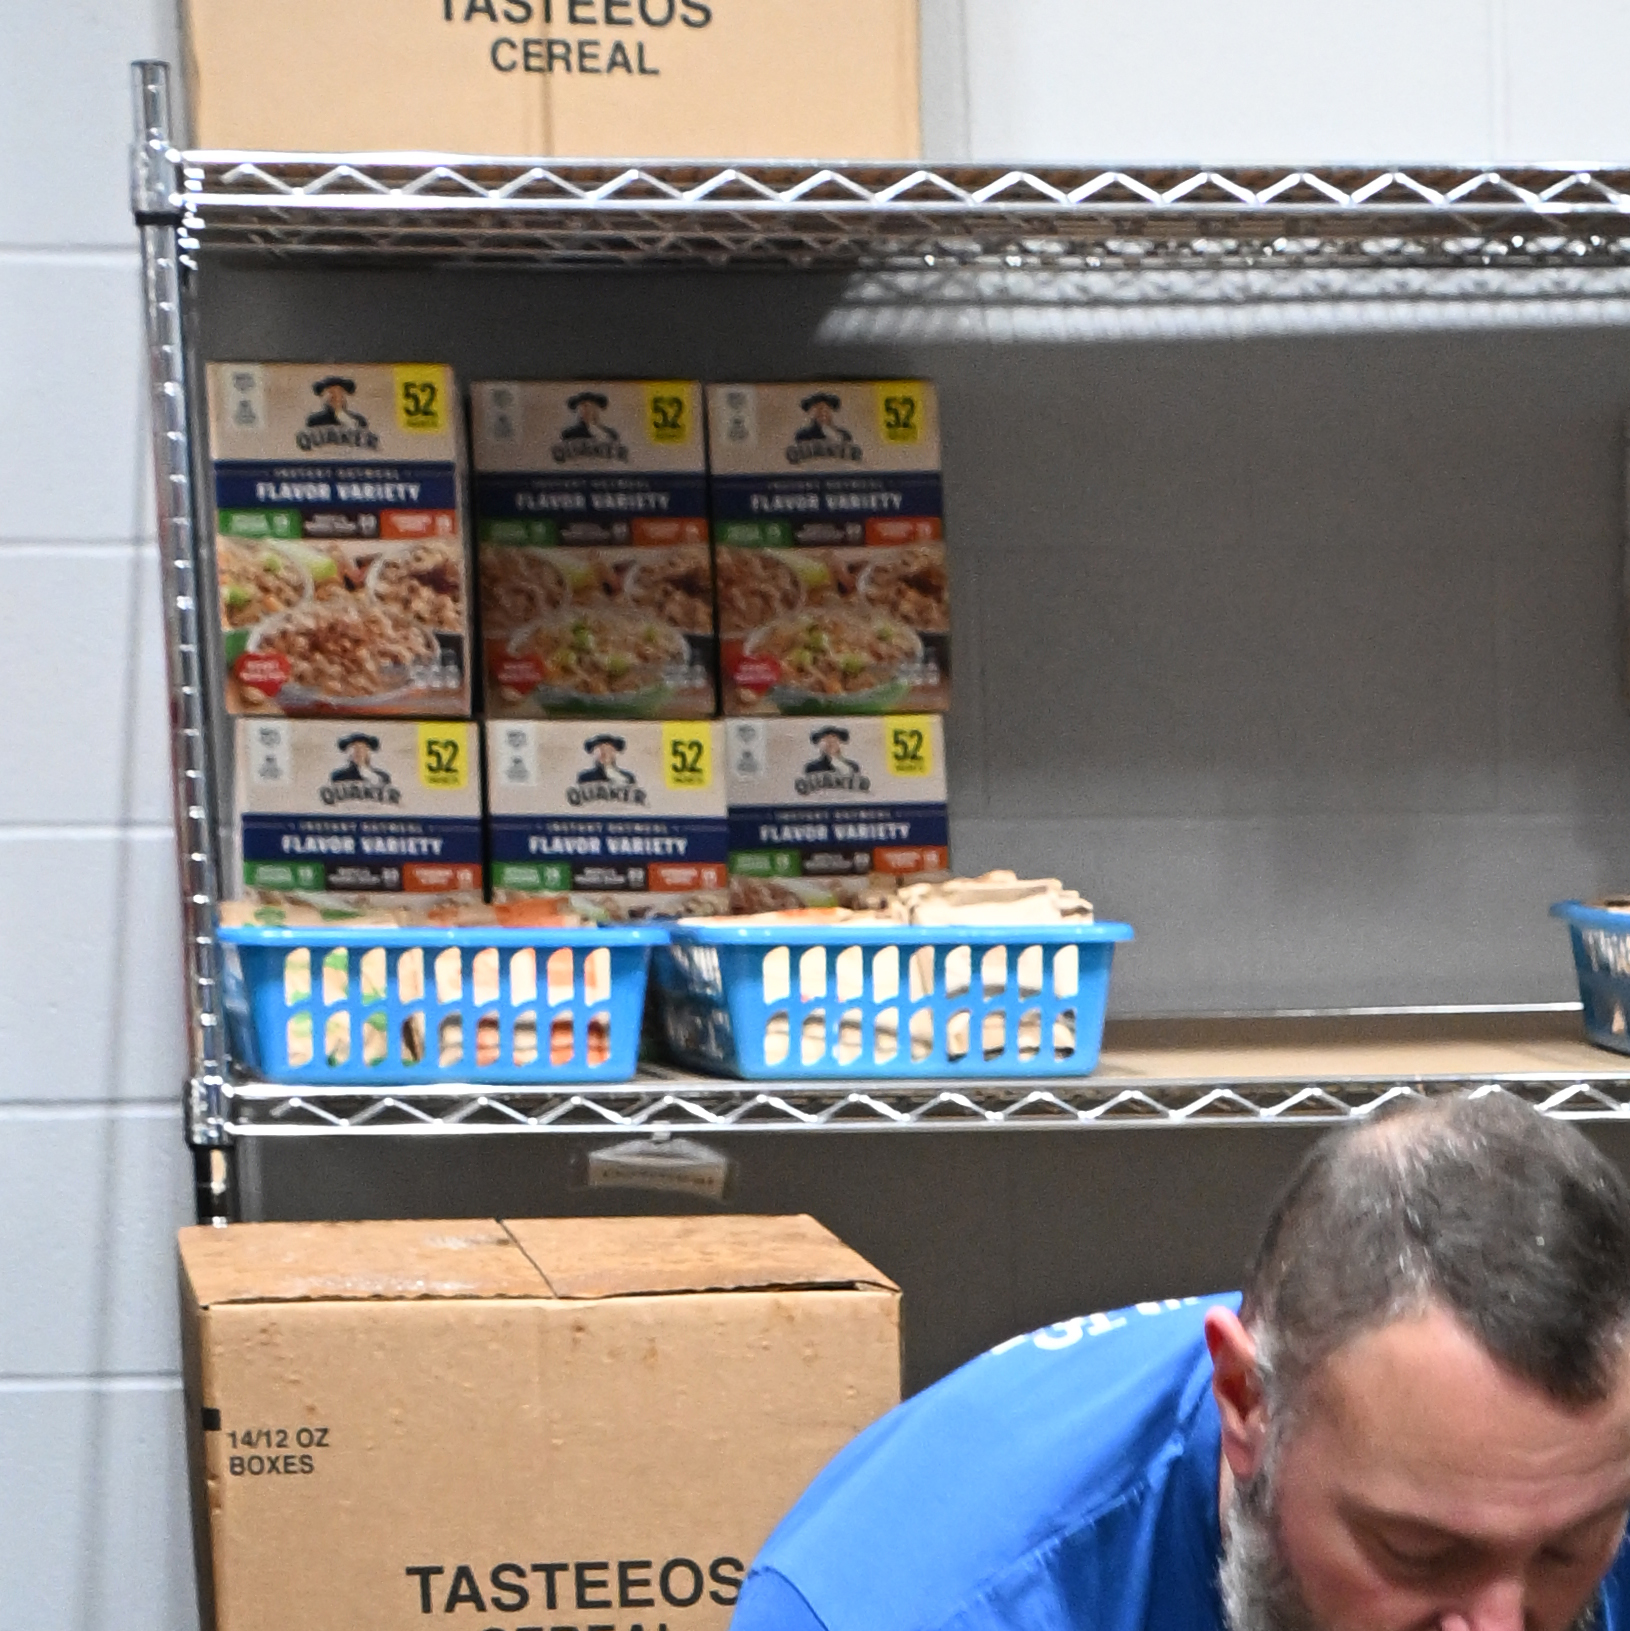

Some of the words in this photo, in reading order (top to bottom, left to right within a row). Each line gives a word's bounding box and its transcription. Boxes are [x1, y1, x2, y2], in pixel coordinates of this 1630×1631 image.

[490, 37, 660, 76] CEREAL
[403, 381, 438, 417] 52
[652, 396, 683, 429] 52
[883, 396, 916, 430] 52
[255, 482, 332, 501] FLAVOR
[337, 482, 421, 501] VARIETY
[425, 739, 460, 774] 52
[670, 739, 704, 775] 52
[891, 729, 924, 763] 52
[281, 836, 356, 854] FLAVOR
[361, 836, 443, 855] VARIETY
[528, 836, 602, 855] FLAVOR
[605, 837, 688, 856] VARIETY
[759, 824, 828, 842] FLAVOR
[834, 822, 911, 841] VARIETY
[226, 1429, 289, 1450] 14/12
[295, 1427, 331, 1449] OZ
[228, 1454, 315, 1477] BOXES
[404, 1556, 747, 1616] TASTEEOS
